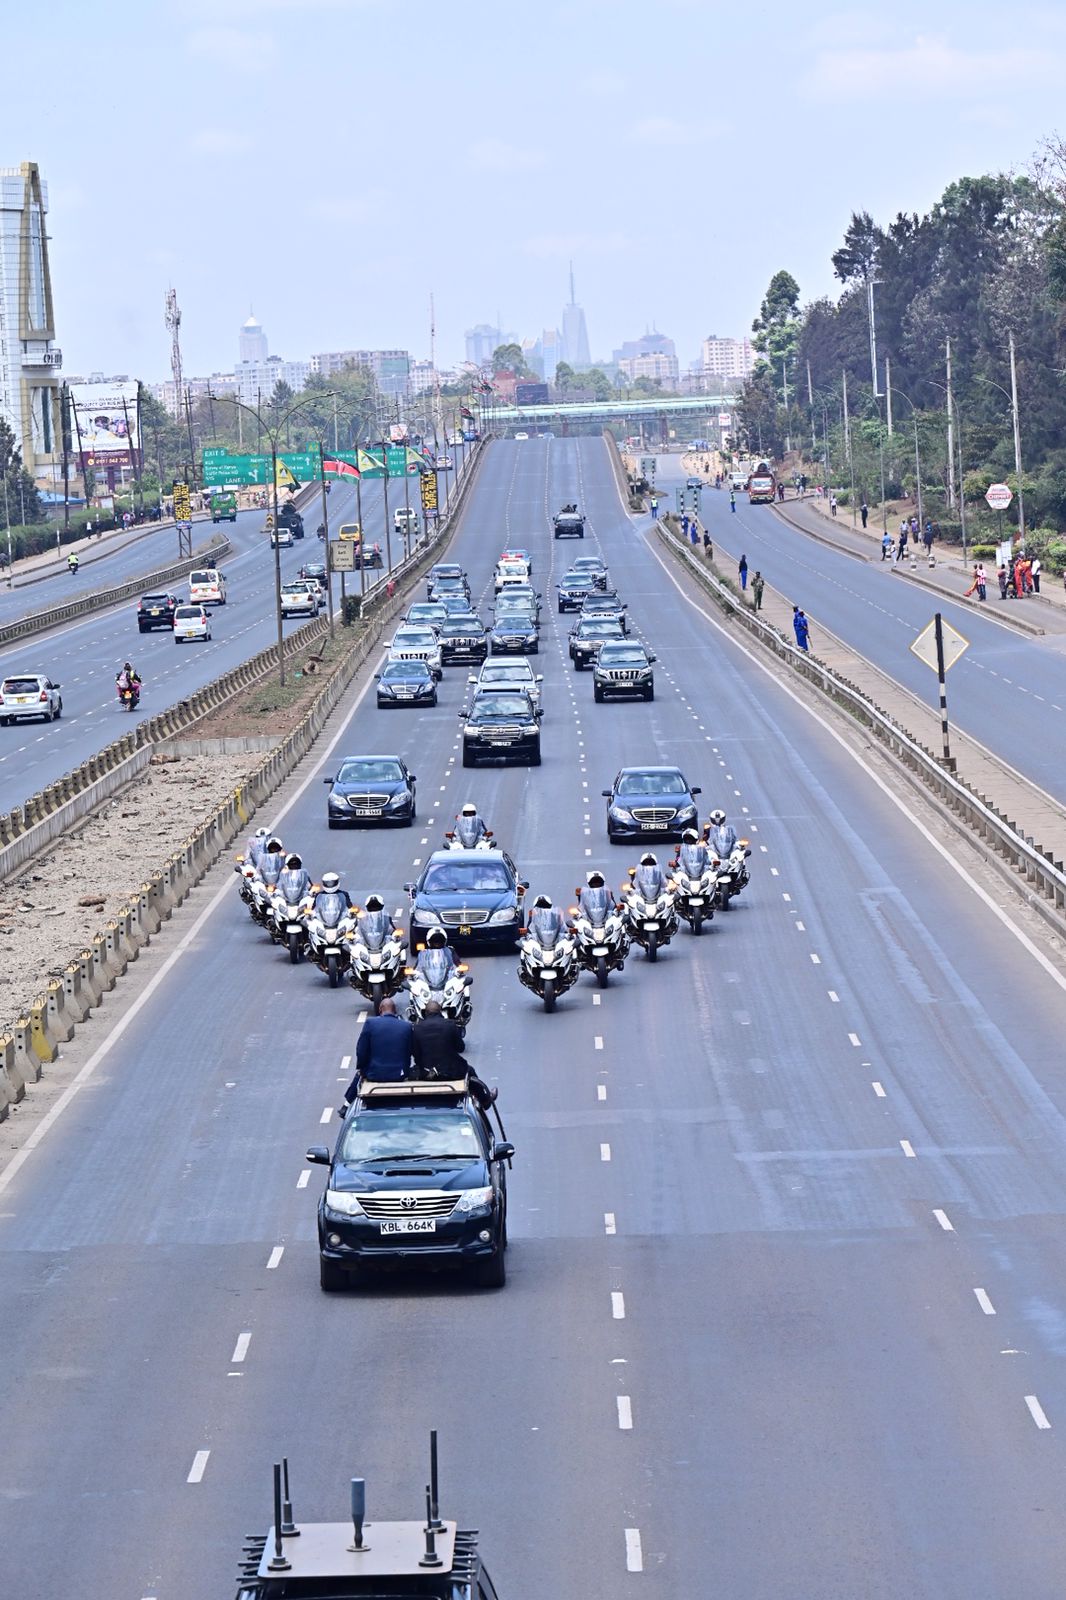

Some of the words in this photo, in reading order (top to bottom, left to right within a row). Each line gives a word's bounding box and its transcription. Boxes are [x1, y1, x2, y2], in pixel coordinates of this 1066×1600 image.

[173, 485, 182, 502] TYRES
[180, 484, 191, 521] REGULARLY
[174, 503, 182, 521] CHECK
[381, 1222, 402, 1232] KBL
[407, 1221, 434, 1231] 664K
